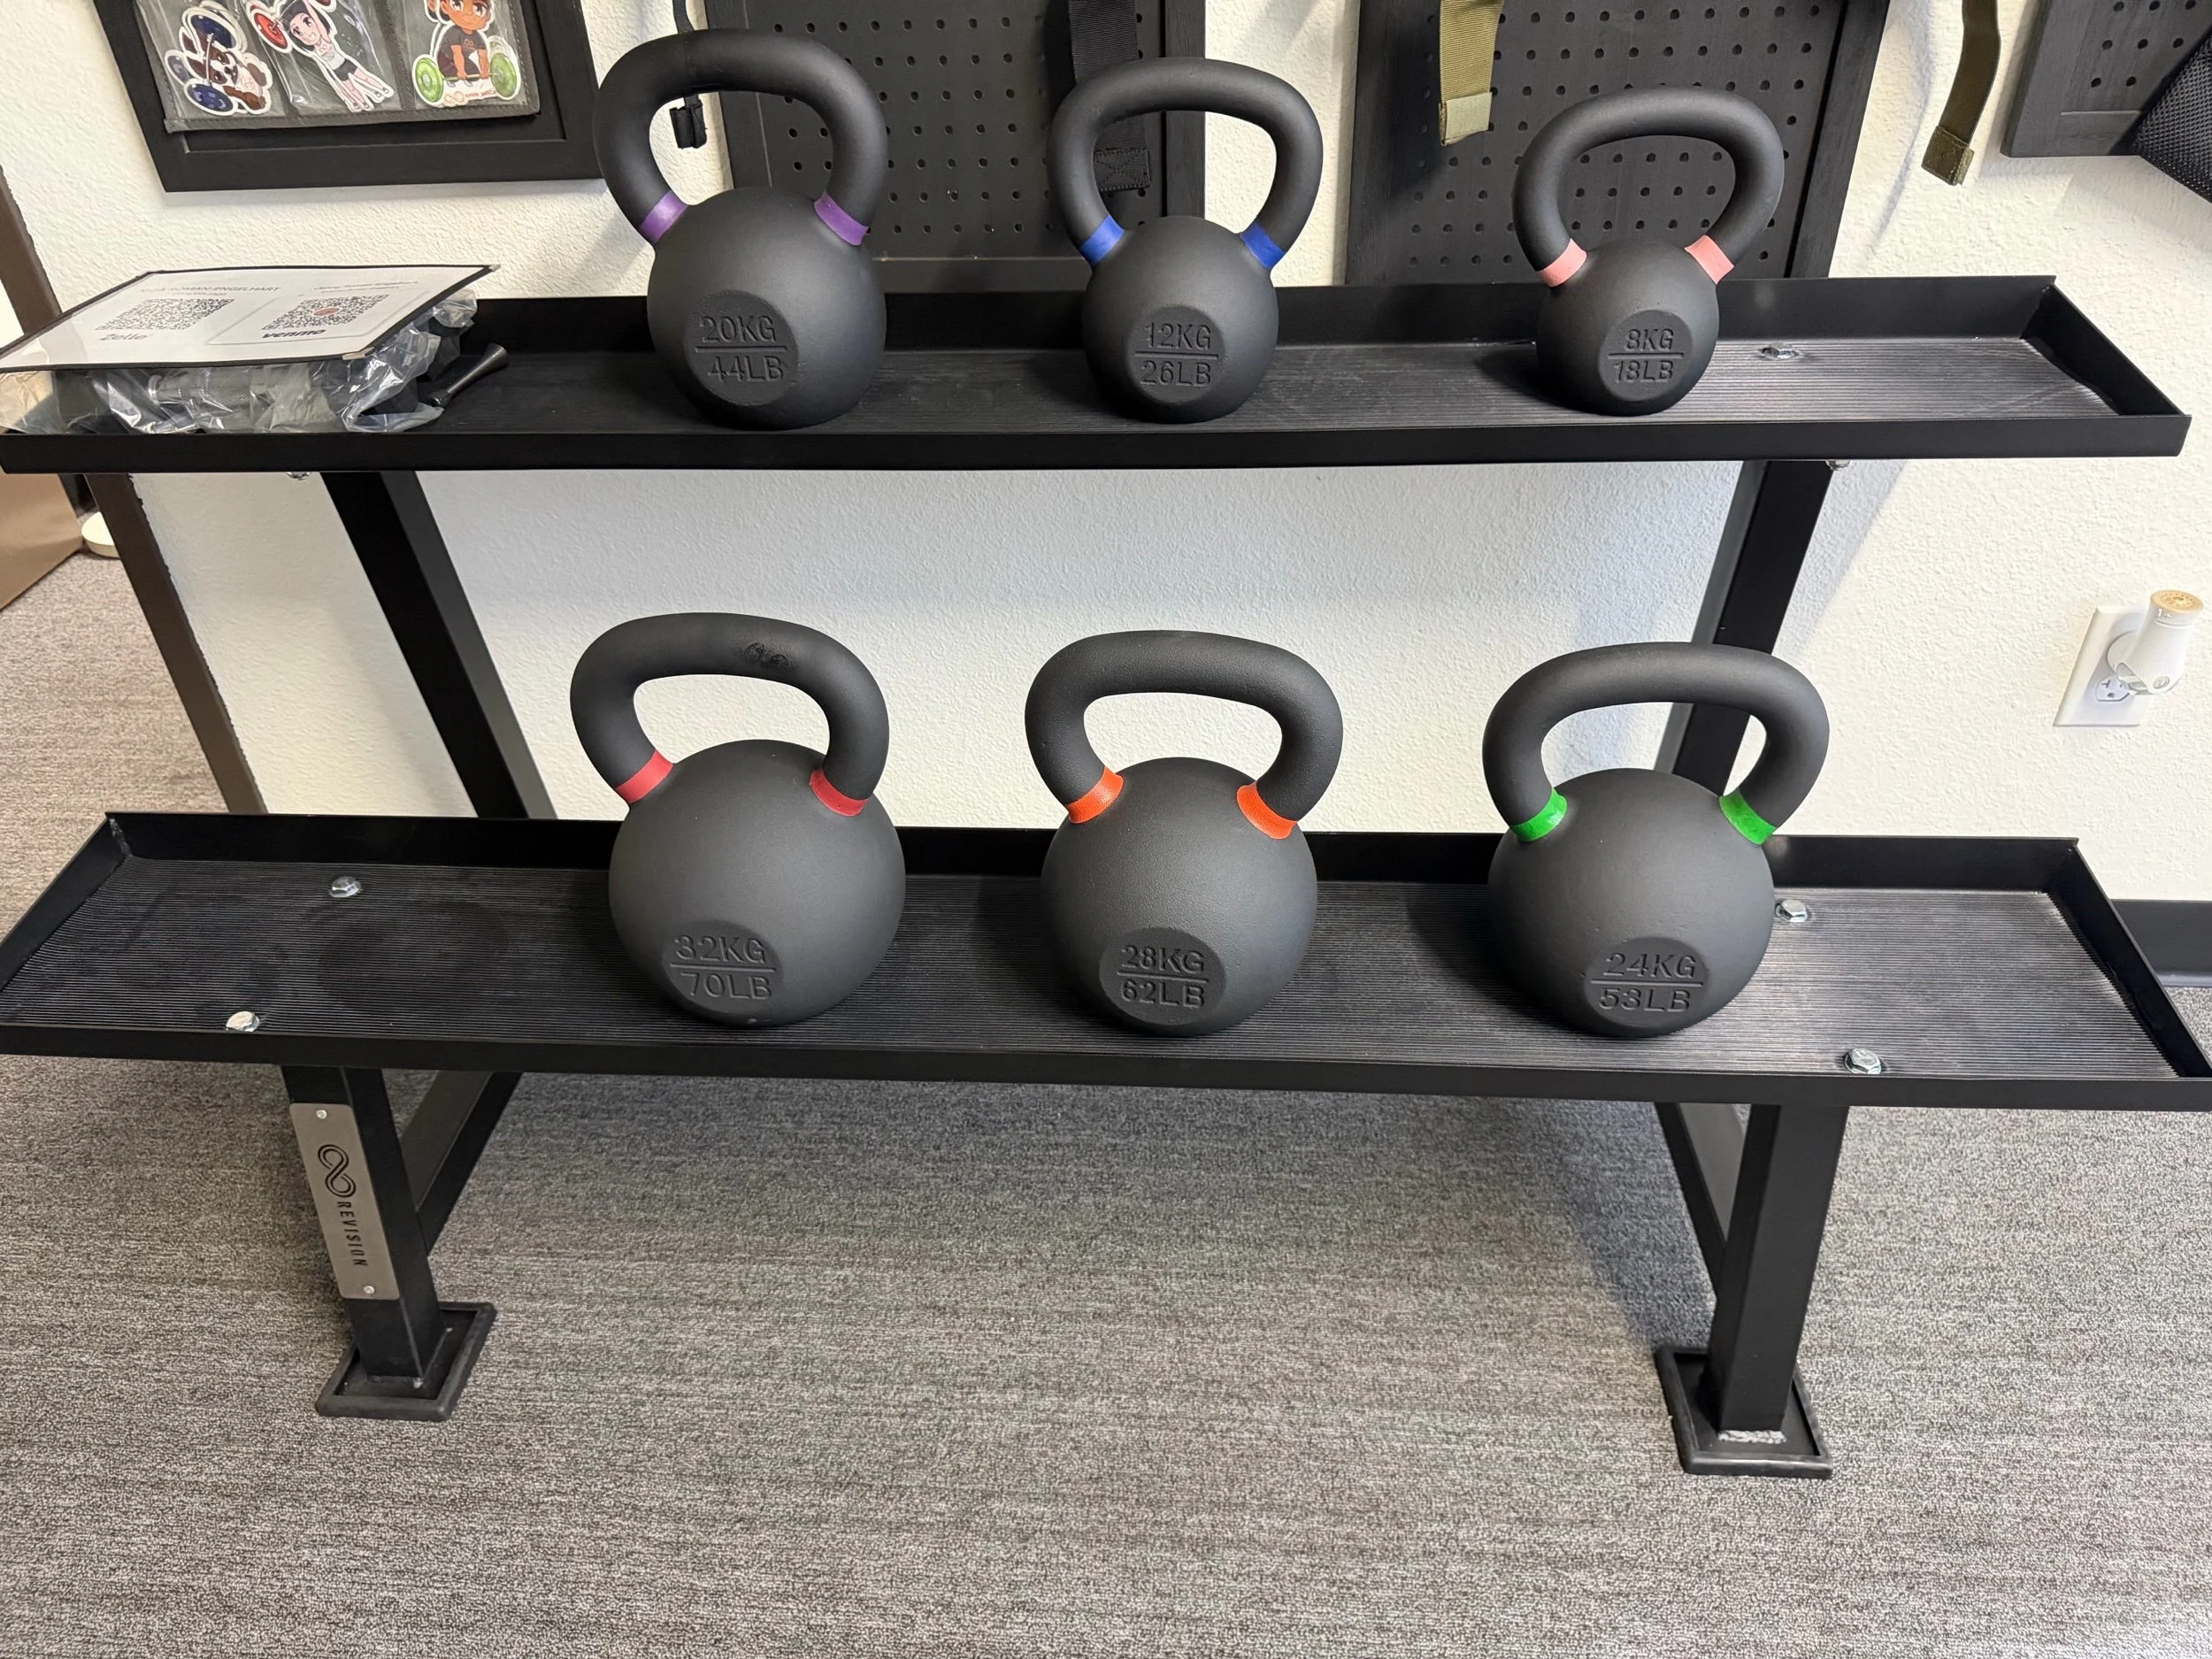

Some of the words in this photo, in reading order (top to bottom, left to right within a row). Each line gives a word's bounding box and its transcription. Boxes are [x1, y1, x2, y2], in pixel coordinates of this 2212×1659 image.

[262, 329, 326, 338] venmo
[701, 315, 776, 343] 20KG
[1145, 322, 1210, 350] 12KG
[1624, 328, 1674, 351] 8KG
[708, 356, 783, 382] 44LB
[1140, 360, 1210, 387] 26LB
[1614, 360, 1674, 382] 18LB
[675, 934, 765, 964] 32KG
[1121, 944, 1204, 973] 28KG
[1603, 953, 1696, 979] 24KG
[680, 972, 772, 1000] 70LB
[1121, 979, 1204, 1009] 62LB
[1599, 987, 1691, 1012] 53LB
[337, 1202, 367, 1266] REVISION
